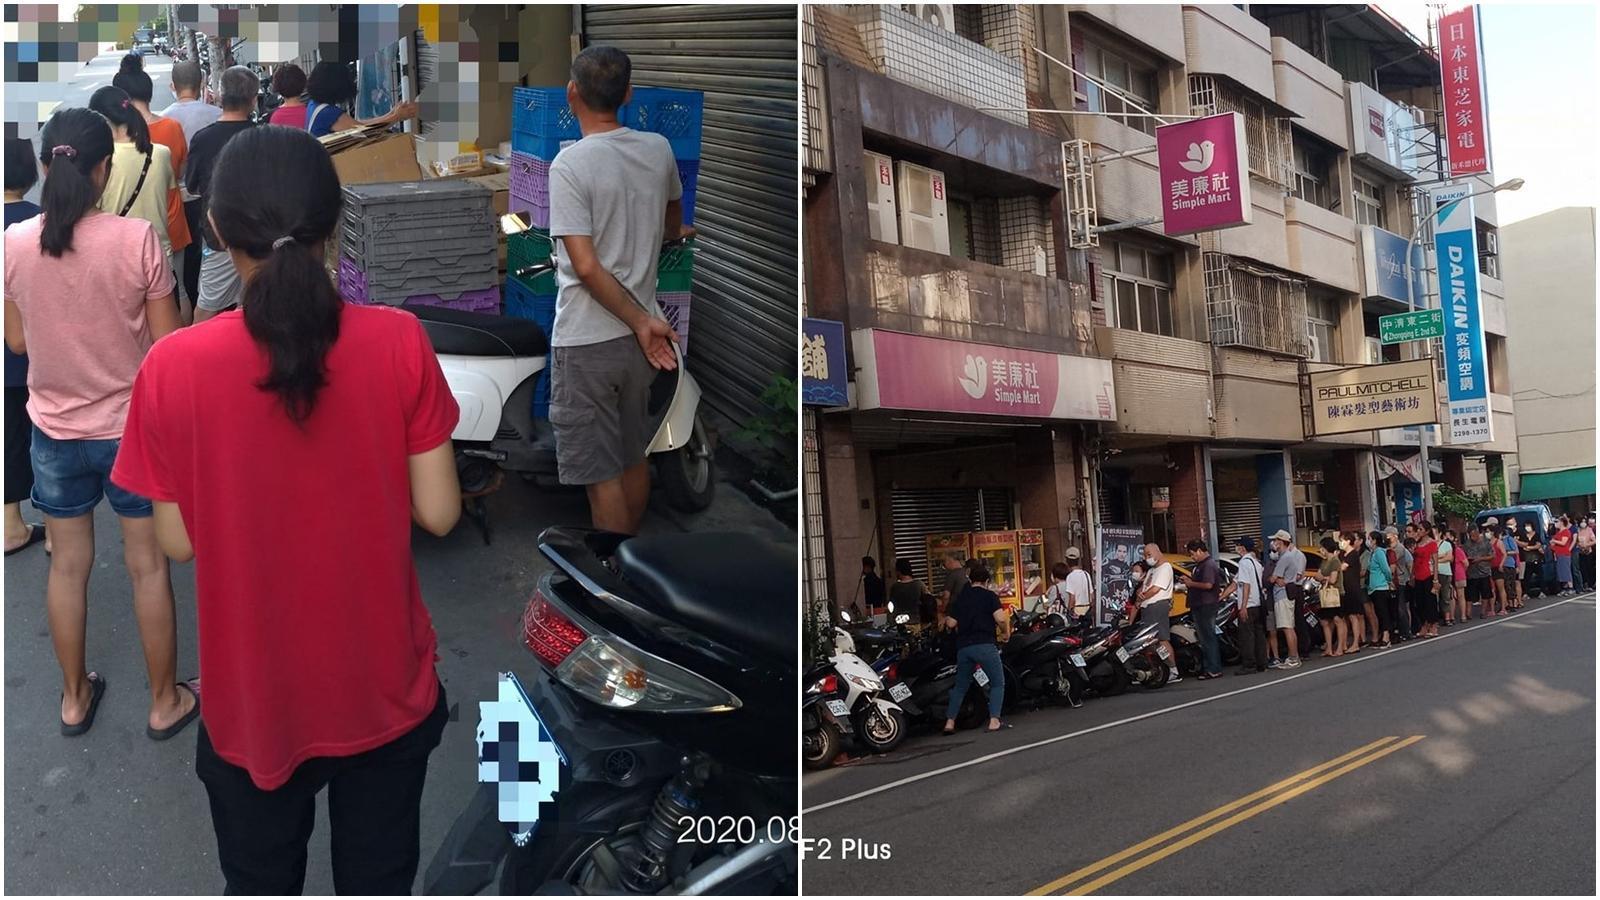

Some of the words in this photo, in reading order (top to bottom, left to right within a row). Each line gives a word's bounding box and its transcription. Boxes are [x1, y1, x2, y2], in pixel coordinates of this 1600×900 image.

[1450, 23, 1476, 149] 日本東芝家電
[1170, 171, 1231, 200] 美廉社
[1172, 196, 1206, 210] Simple
[1207, 191, 1232, 205] Mart
[1436, 191, 1466, 201] DAIKIN
[1448, 245, 1469, 329] DAIKIN
[1382, 312, 1442, 330] 中清東二街
[1420, 327, 1430, 337] 2nd
[991, 359, 1040, 389] 美廉社
[995, 388, 1022, 406] Simple
[1022, 391, 1041, 405] Mart
